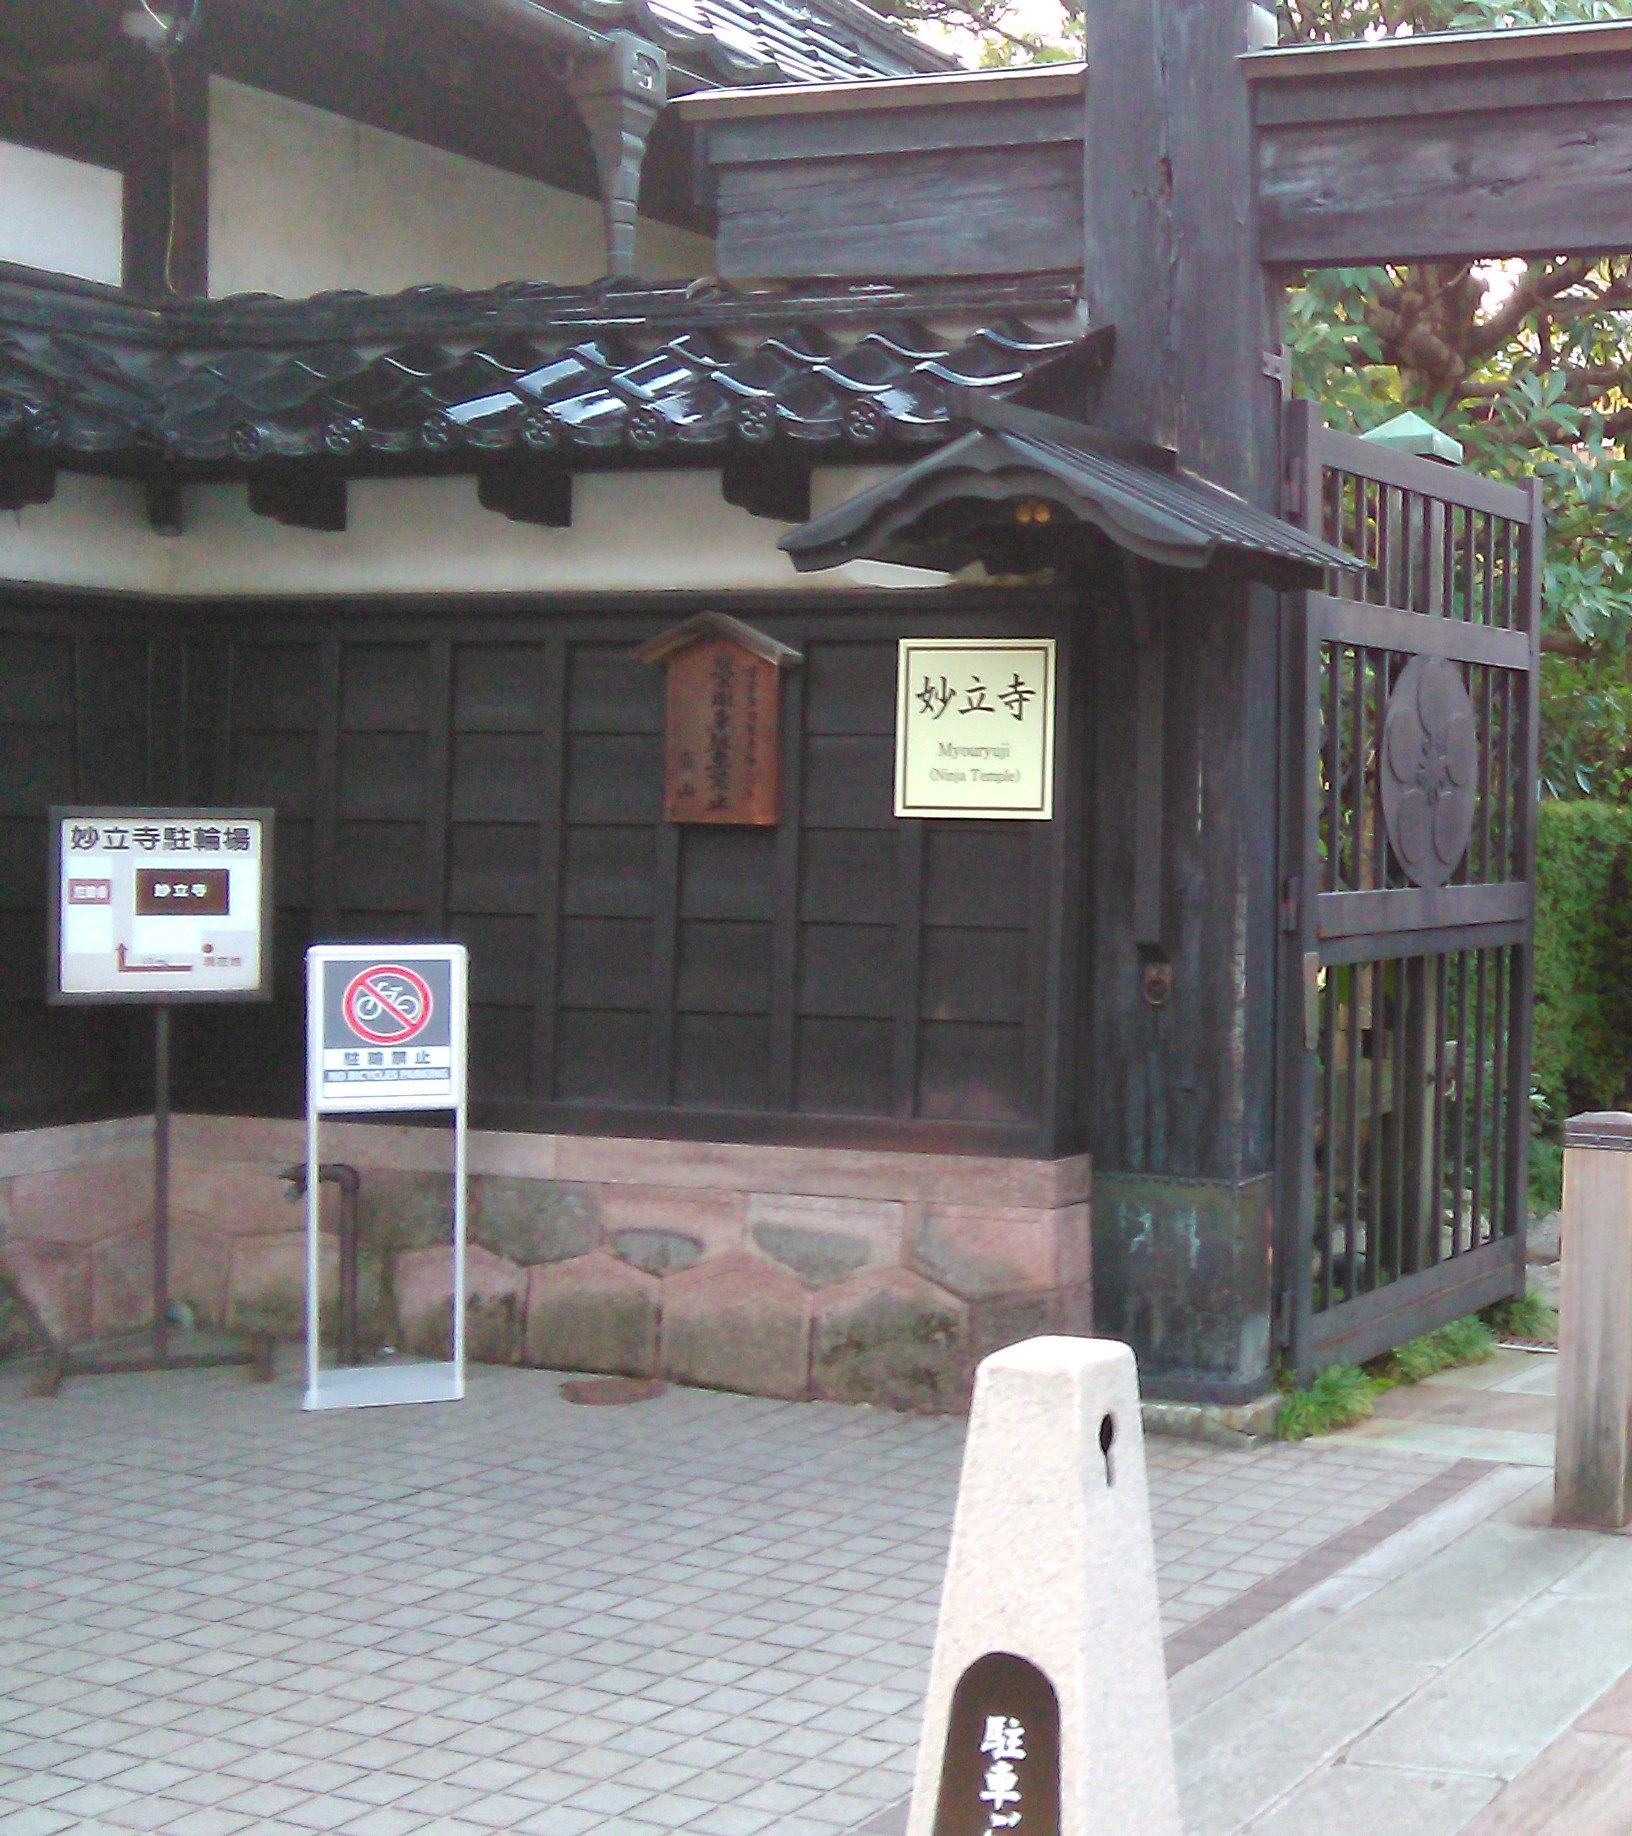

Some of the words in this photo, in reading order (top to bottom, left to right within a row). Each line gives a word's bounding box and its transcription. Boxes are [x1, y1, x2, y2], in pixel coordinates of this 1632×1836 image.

[915, 672, 1037, 721] 妙立寺
[937, 742, 1010, 760] Myouryuji
[929, 767, 967, 783] (Ninja
[970, 767, 1021, 784] Temple)
[71, 825, 251, 851] 妙立寺駐輪場
[154, 882, 208, 898] 妙立寺
